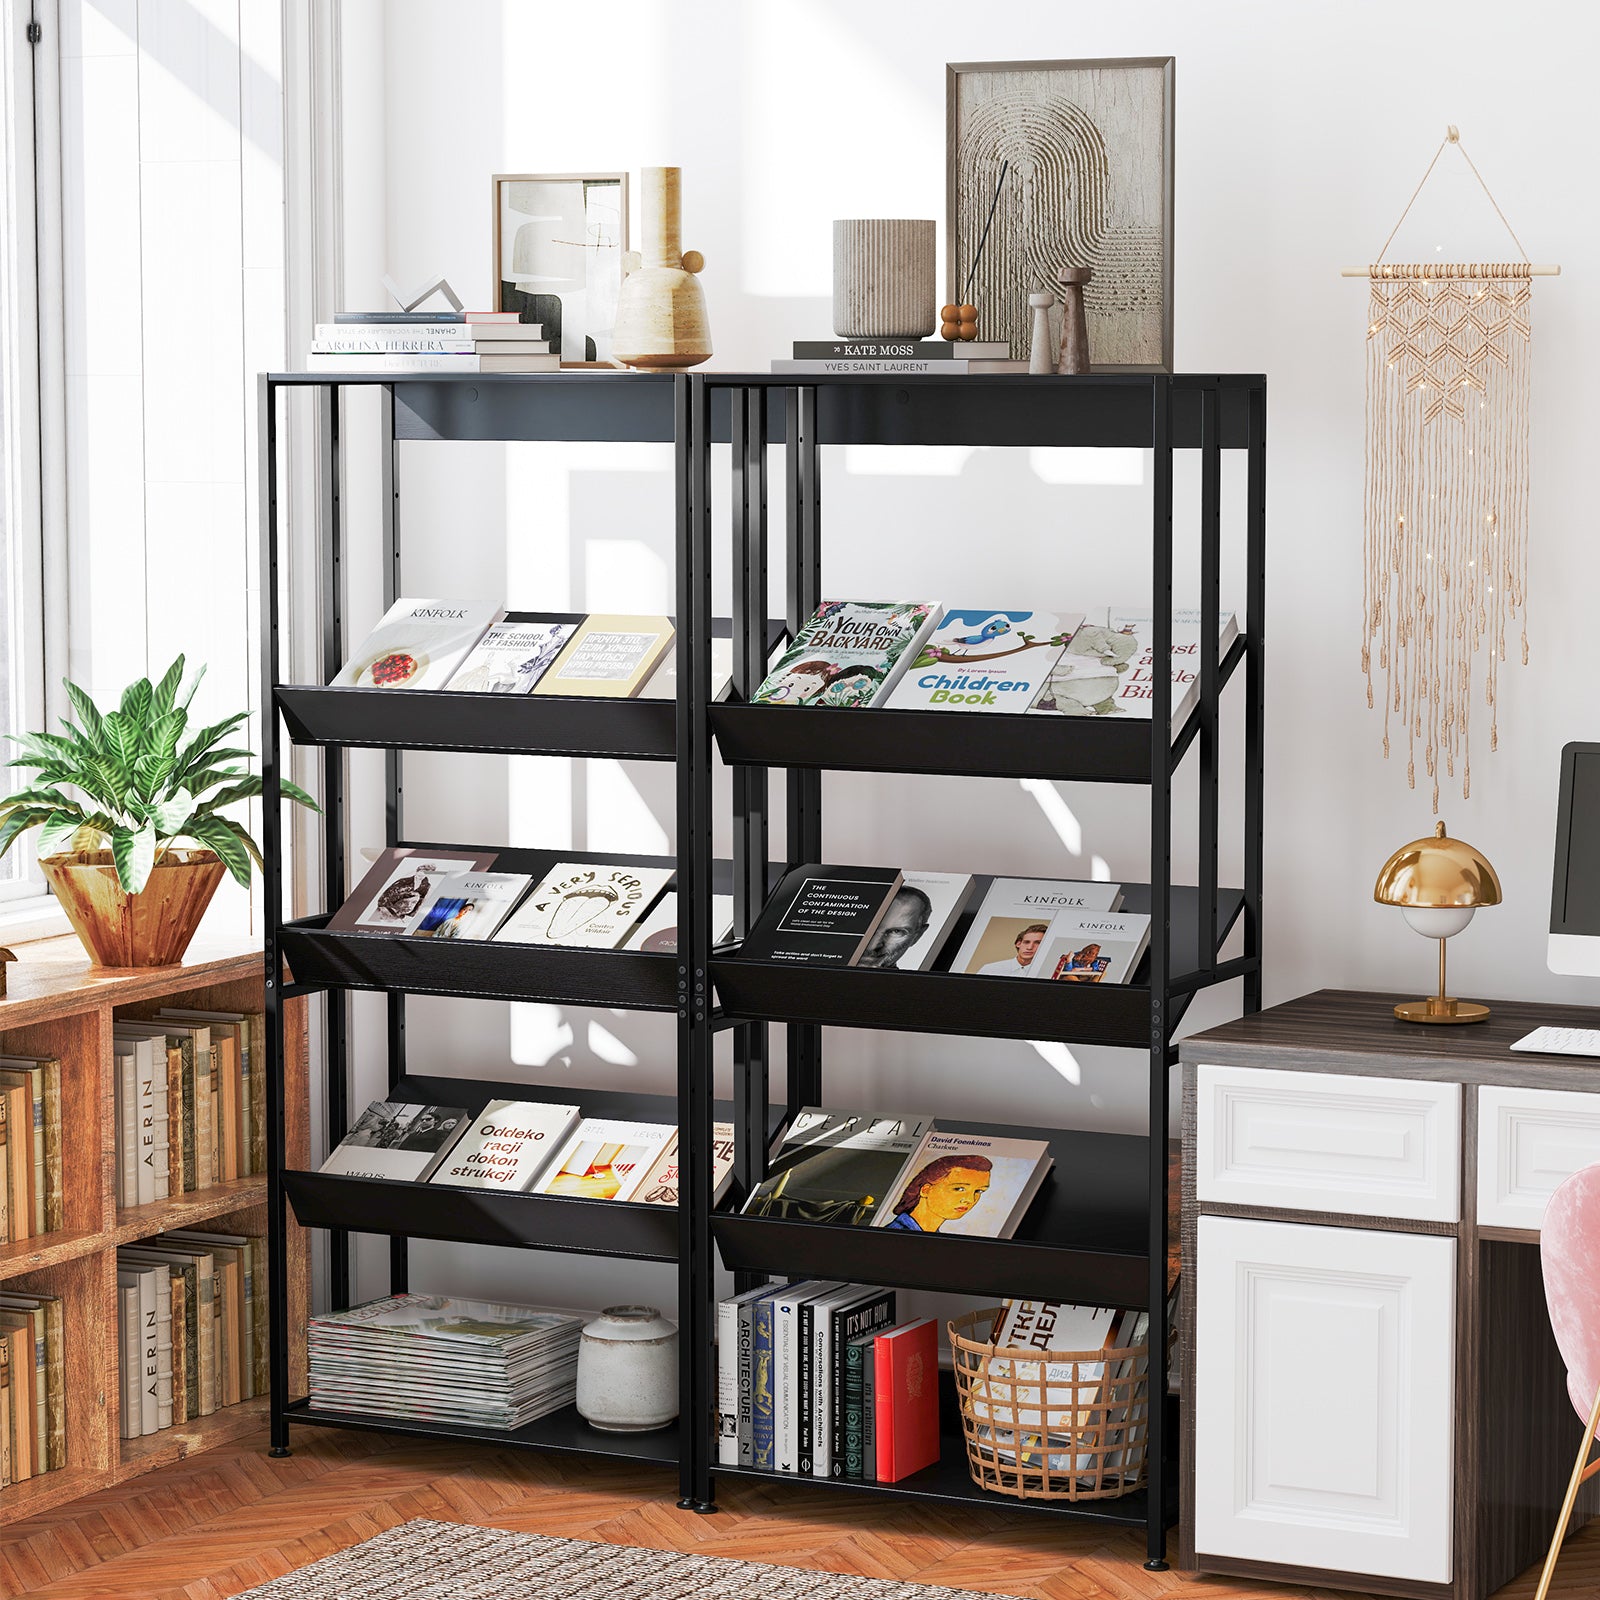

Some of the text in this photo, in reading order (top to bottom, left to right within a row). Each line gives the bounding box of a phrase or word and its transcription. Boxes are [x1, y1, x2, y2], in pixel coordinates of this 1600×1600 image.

[316, 340, 444, 350] CAROLINA HERRERA
[844, 345, 877, 355] KATE
[880, 345, 914, 355] MOSS
[825, 363, 849, 371] YVES
[852, 363, 880, 371] SAINT
[410, 608, 468, 618] KINFOLK
[822, 616, 902, 637] IN YOUR OWN
[808, 630, 894, 650] BACKYARD
[918, 675, 1030, 692] Children
[929, 690, 997, 705] Book
[535, 872, 644, 916] A VERY SERIOUS
[1024, 896, 1085, 906] KINFOLK
[802, 900, 870, 909] CONTAMINATION
[1079, 922, 1126, 930] KINFOLK
[143, 1080, 153, 1167] AERIN
[796, 1113, 922, 1138] CEREAL
[480, 1125, 545, 1140] Oddeko
[483, 1142, 523, 1154] racji
[953, 1138, 992, 1146] Foenkinos
[466, 1152, 519, 1166] dokon
[450, 1166, 517, 1182] strukcji
[847, 1314, 859, 1335] IT'S
[860, 1308, 872, 1330] NOT
[874, 1301, 888, 1324] HOW
[1006, 1300, 1035, 1349] ТКР
[146, 1310, 157, 1396] AERIN
[741, 1319, 750, 1423] ARCHITECTURE
